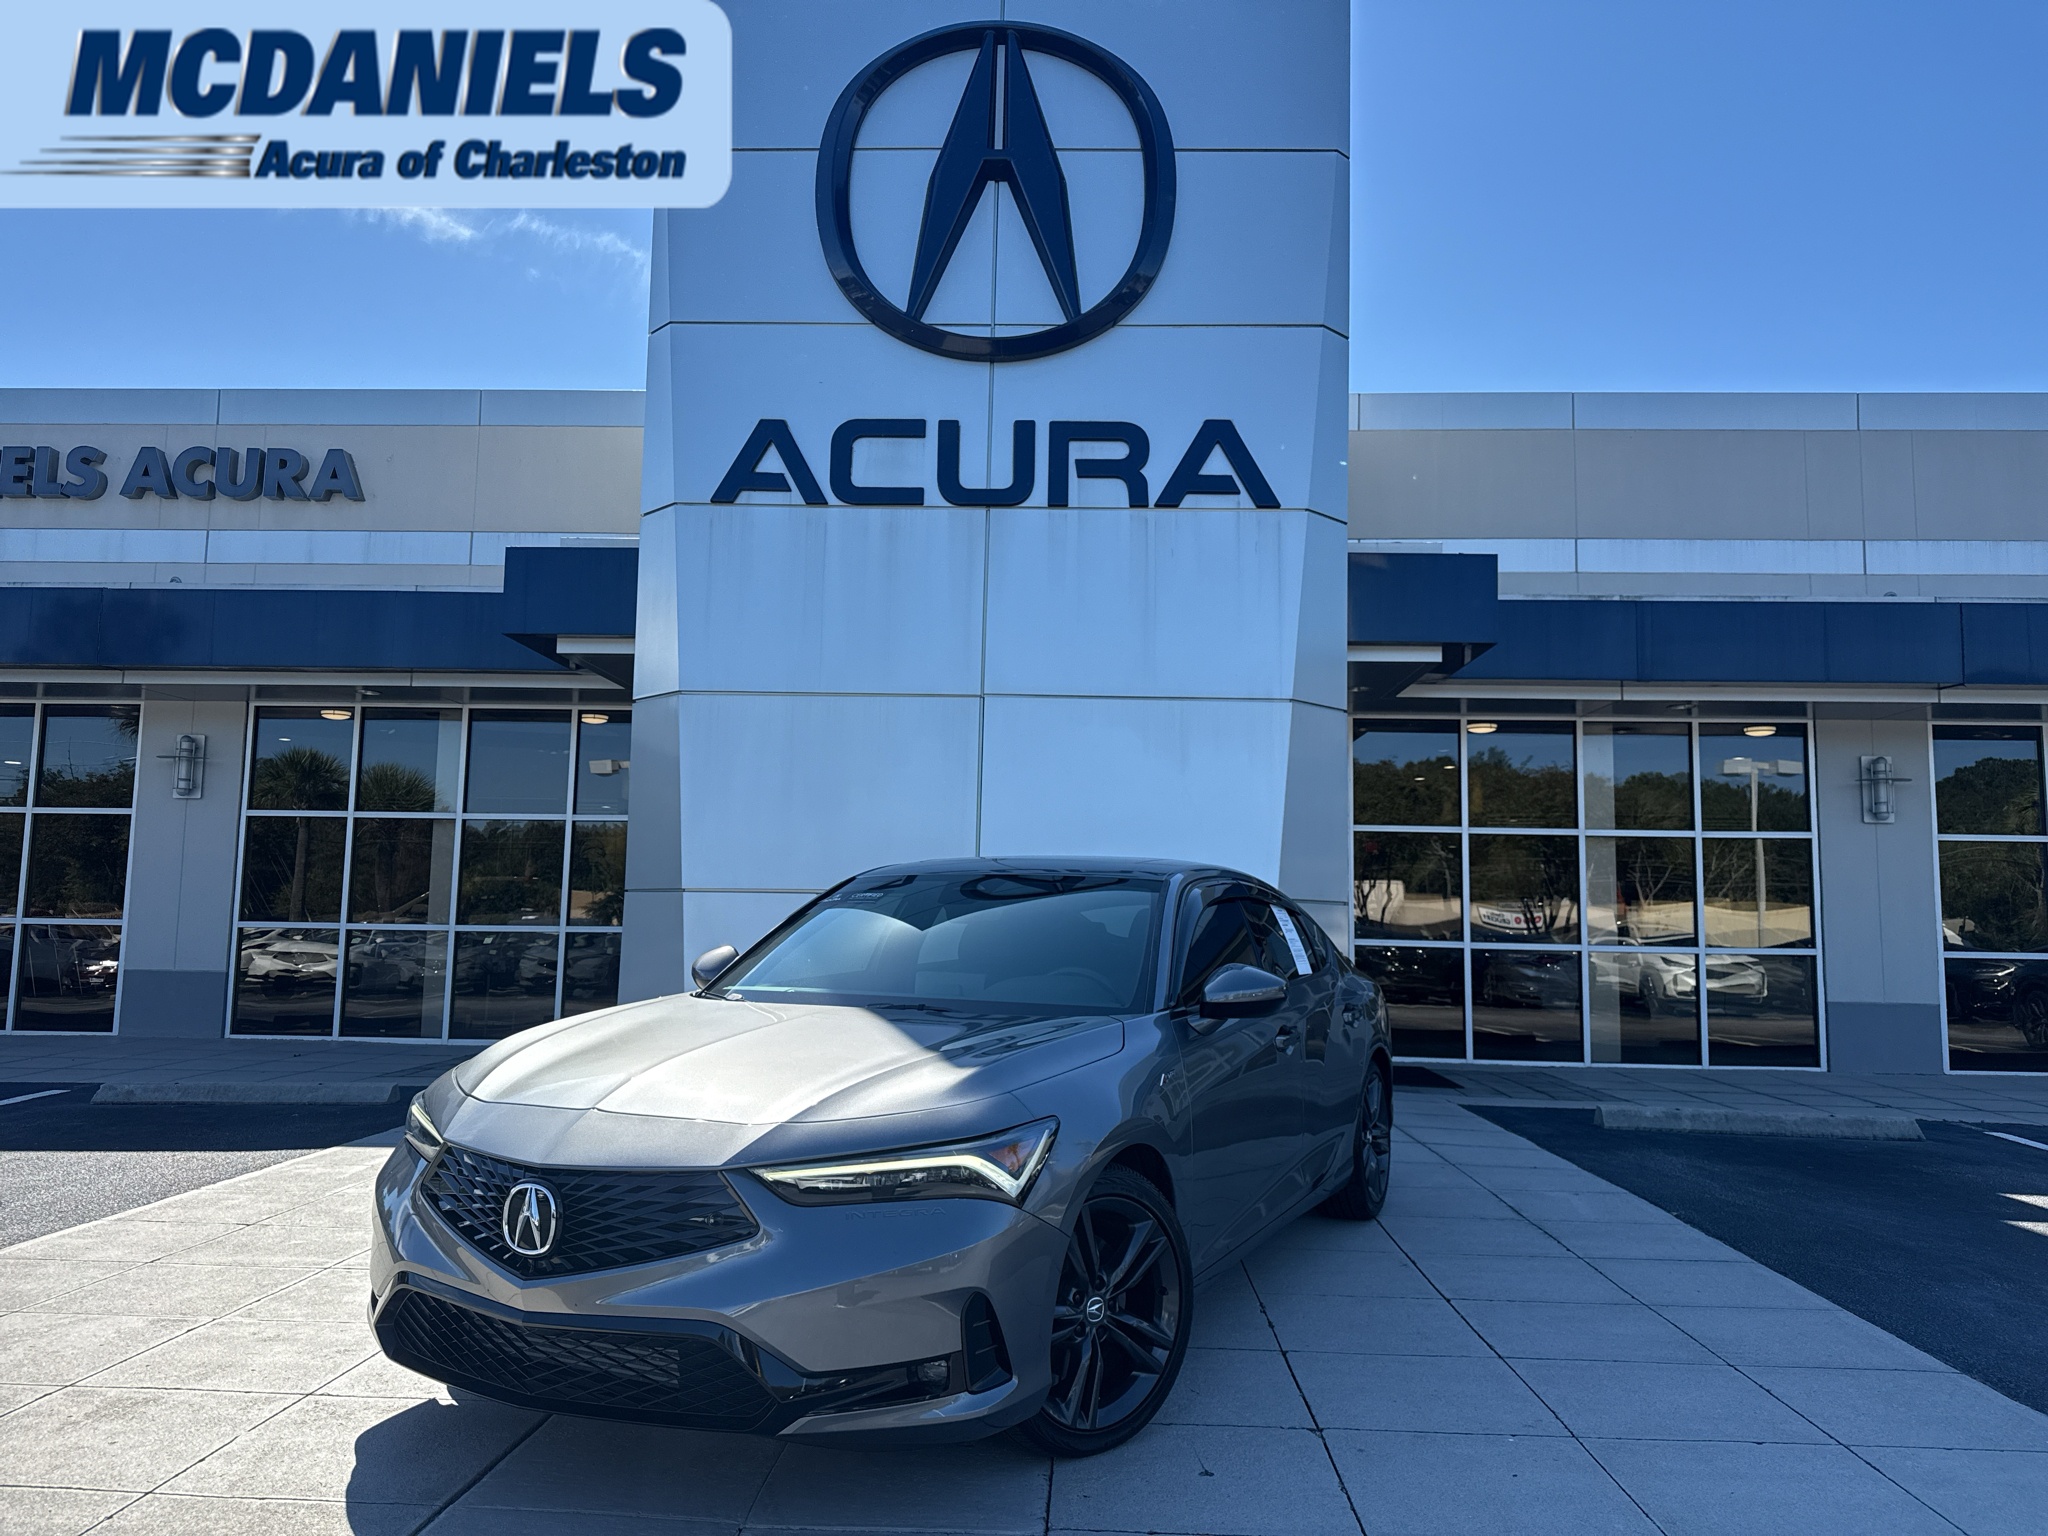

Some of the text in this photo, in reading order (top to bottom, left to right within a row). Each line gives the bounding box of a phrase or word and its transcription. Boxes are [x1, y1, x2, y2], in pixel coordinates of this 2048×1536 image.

[119, 446, 366, 502] ACURA
[710, 418, 1281, 508] ACURA
[845, 1206, 946, 1220] INTEGRA
